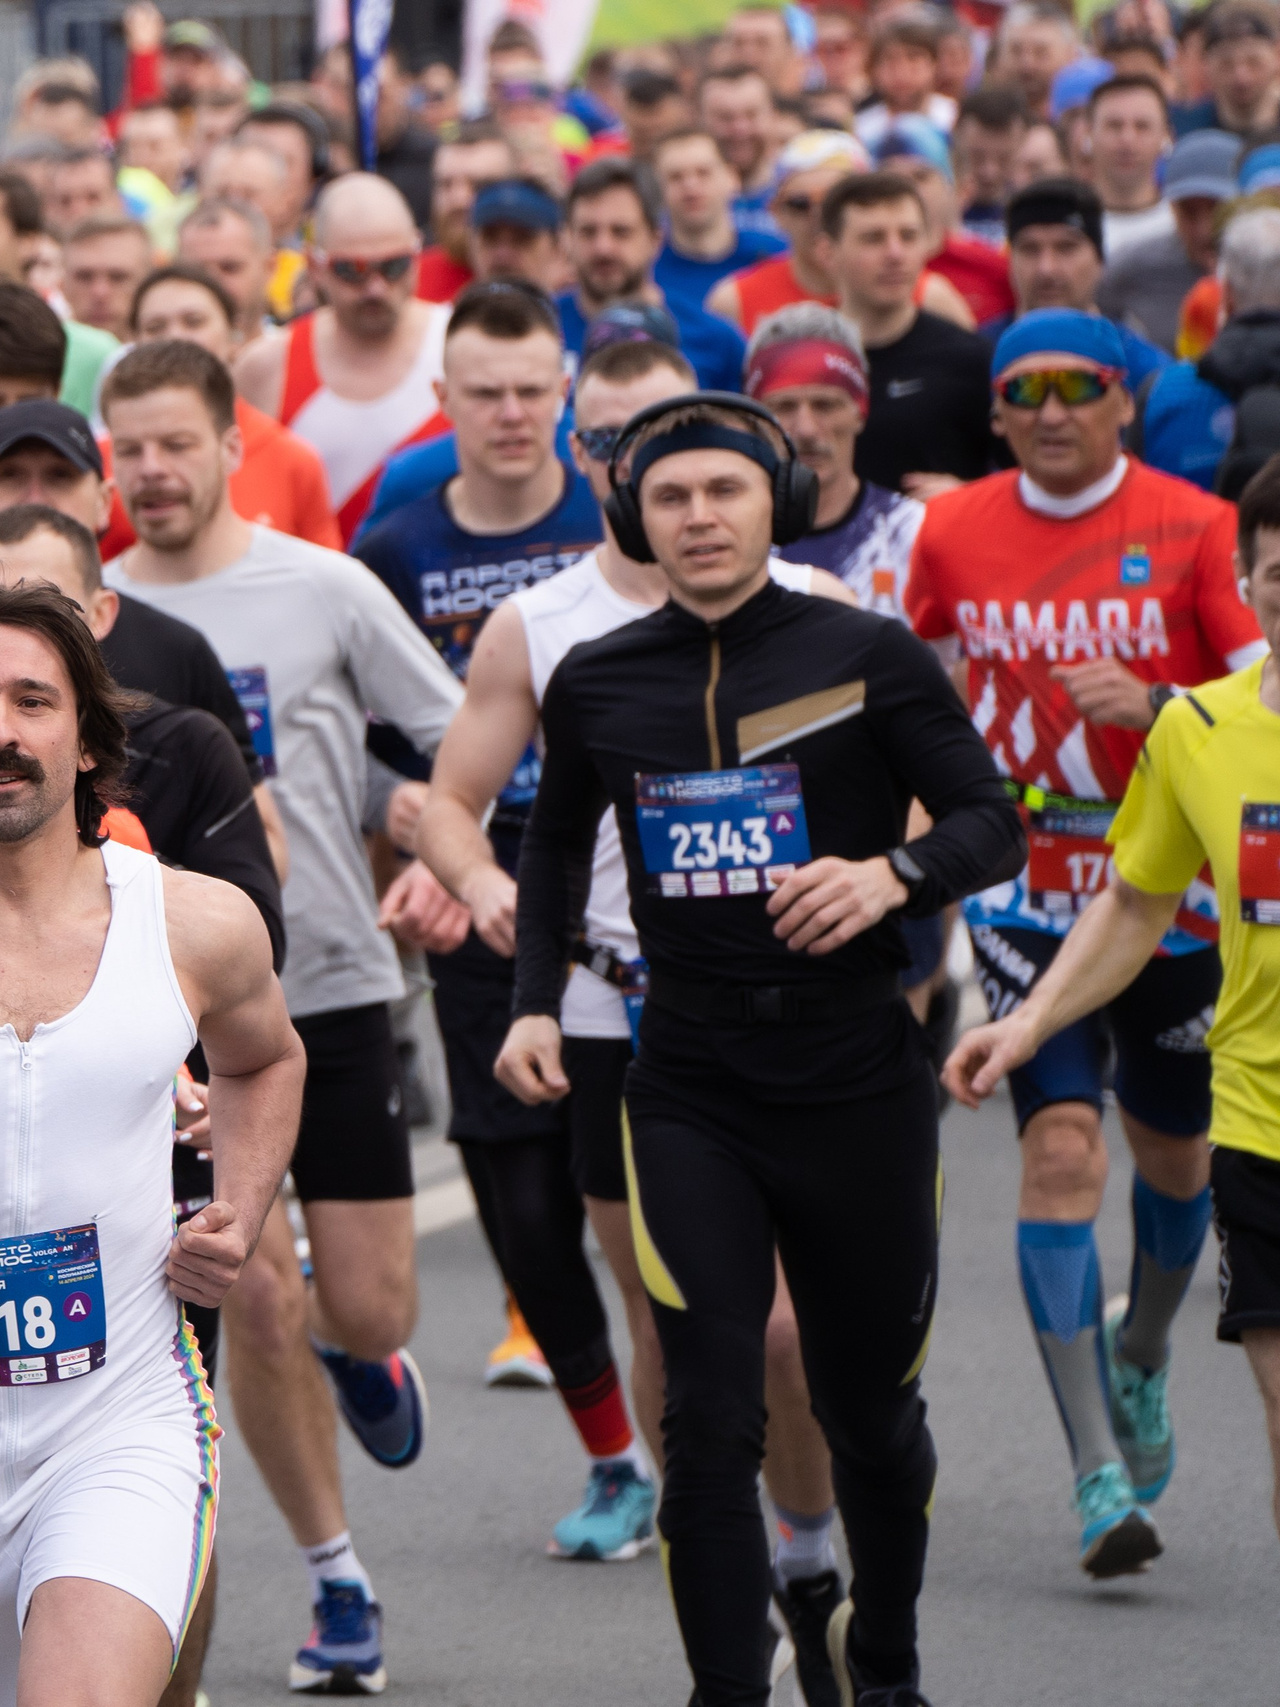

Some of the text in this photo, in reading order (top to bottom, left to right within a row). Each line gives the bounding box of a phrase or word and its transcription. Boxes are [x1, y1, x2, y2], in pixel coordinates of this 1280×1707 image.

[451, 552, 589, 591] ПРОСТ
[956, 598, 1169, 661] SAMARA
[668, 816, 773, 870] 2343
